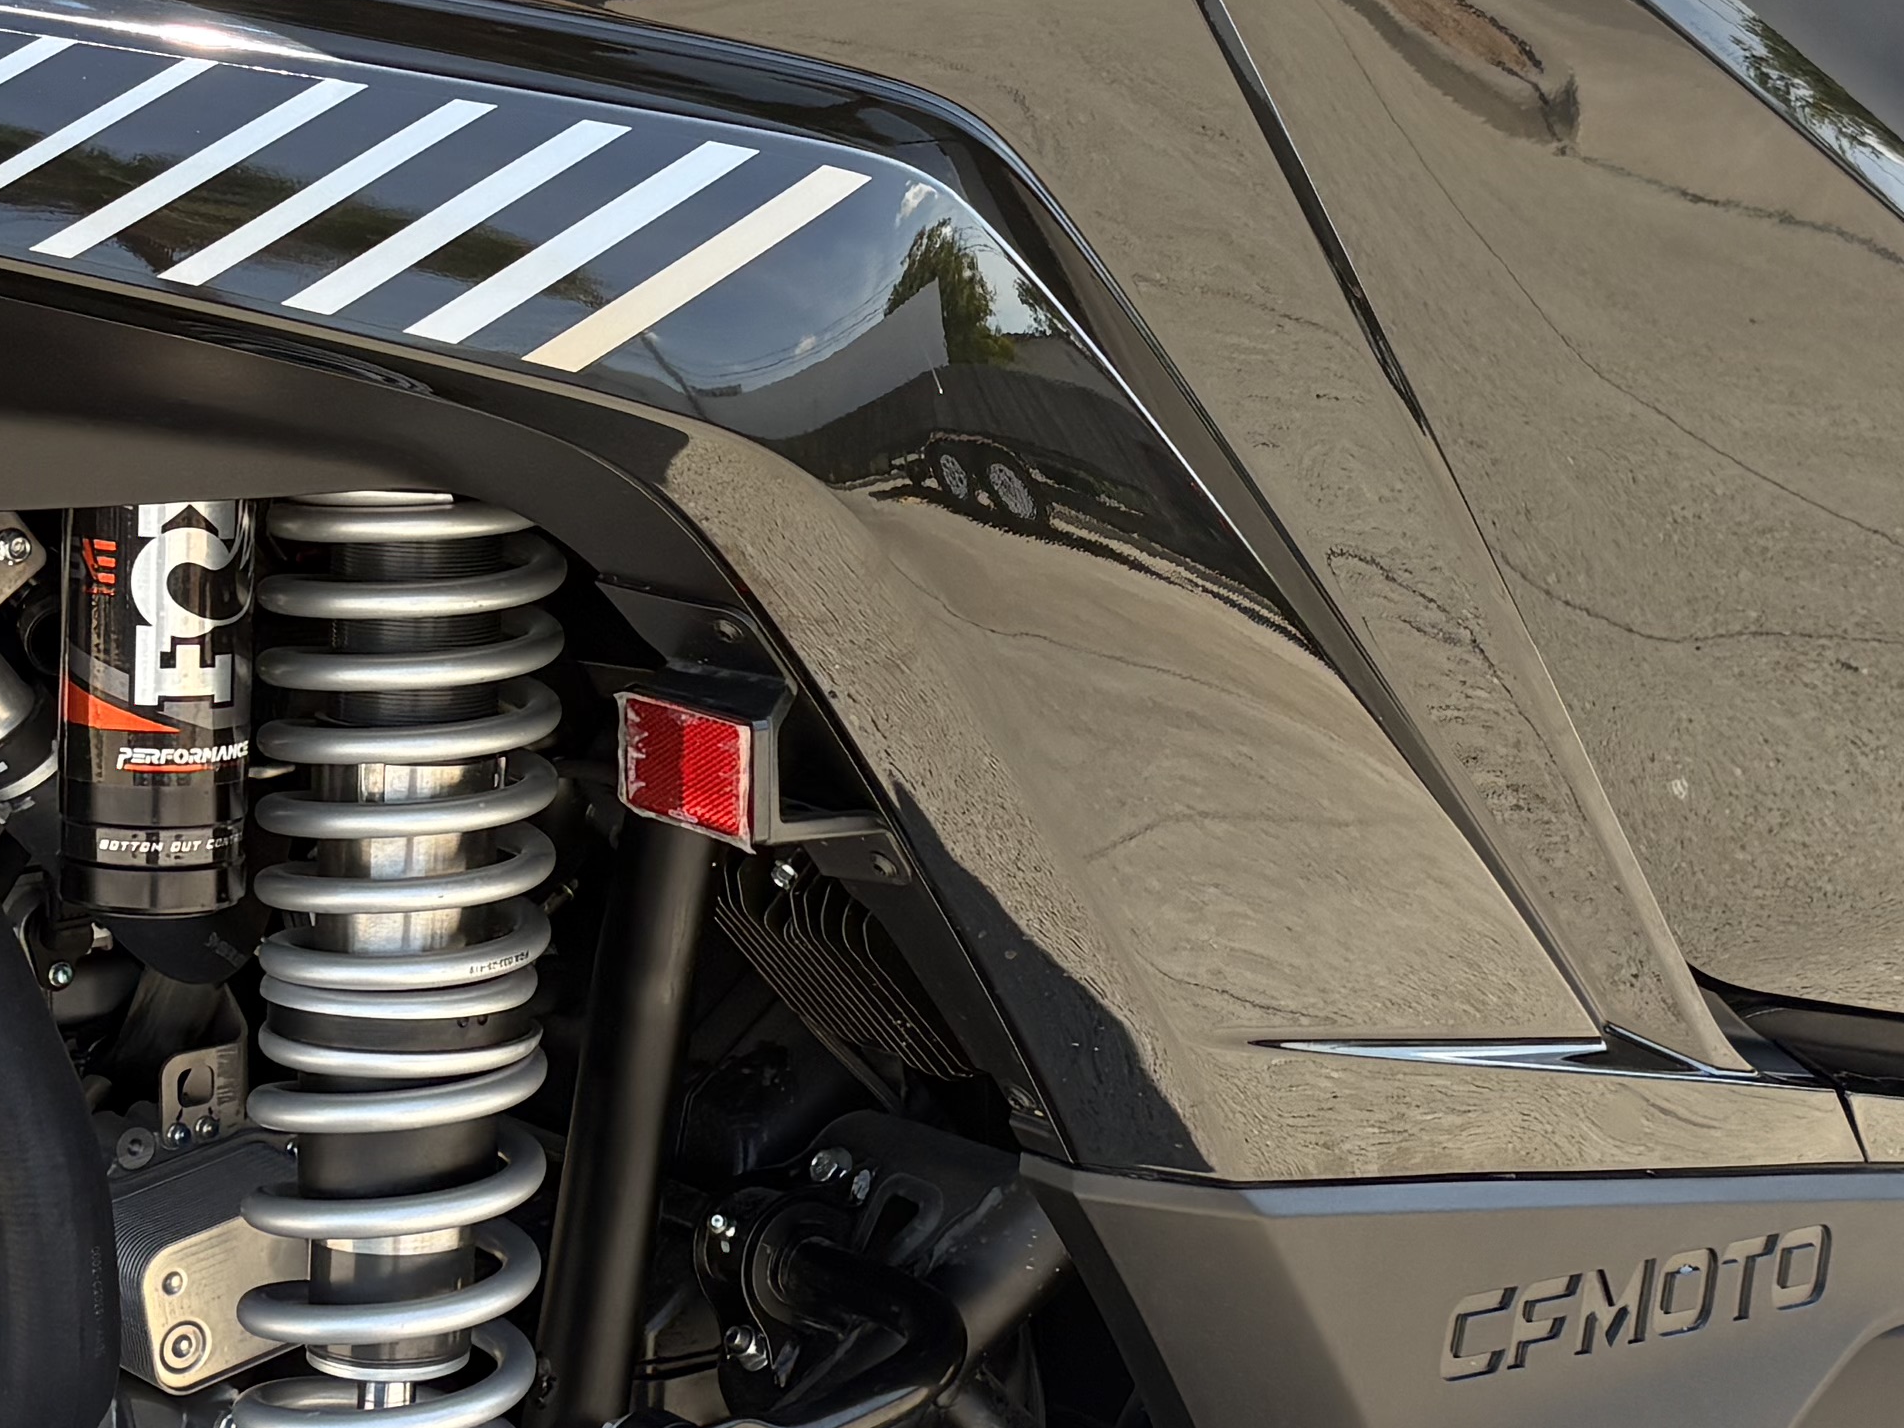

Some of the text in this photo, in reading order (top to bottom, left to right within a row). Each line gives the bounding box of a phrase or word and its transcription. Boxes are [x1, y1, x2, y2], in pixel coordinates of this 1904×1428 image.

[116, 739, 249, 770] PERFORMANCE
[98, 838, 163, 853] BOTTOM
[170, 840, 202, 853] OUT
[1439, 1223, 1833, 1382] CFMOTO
